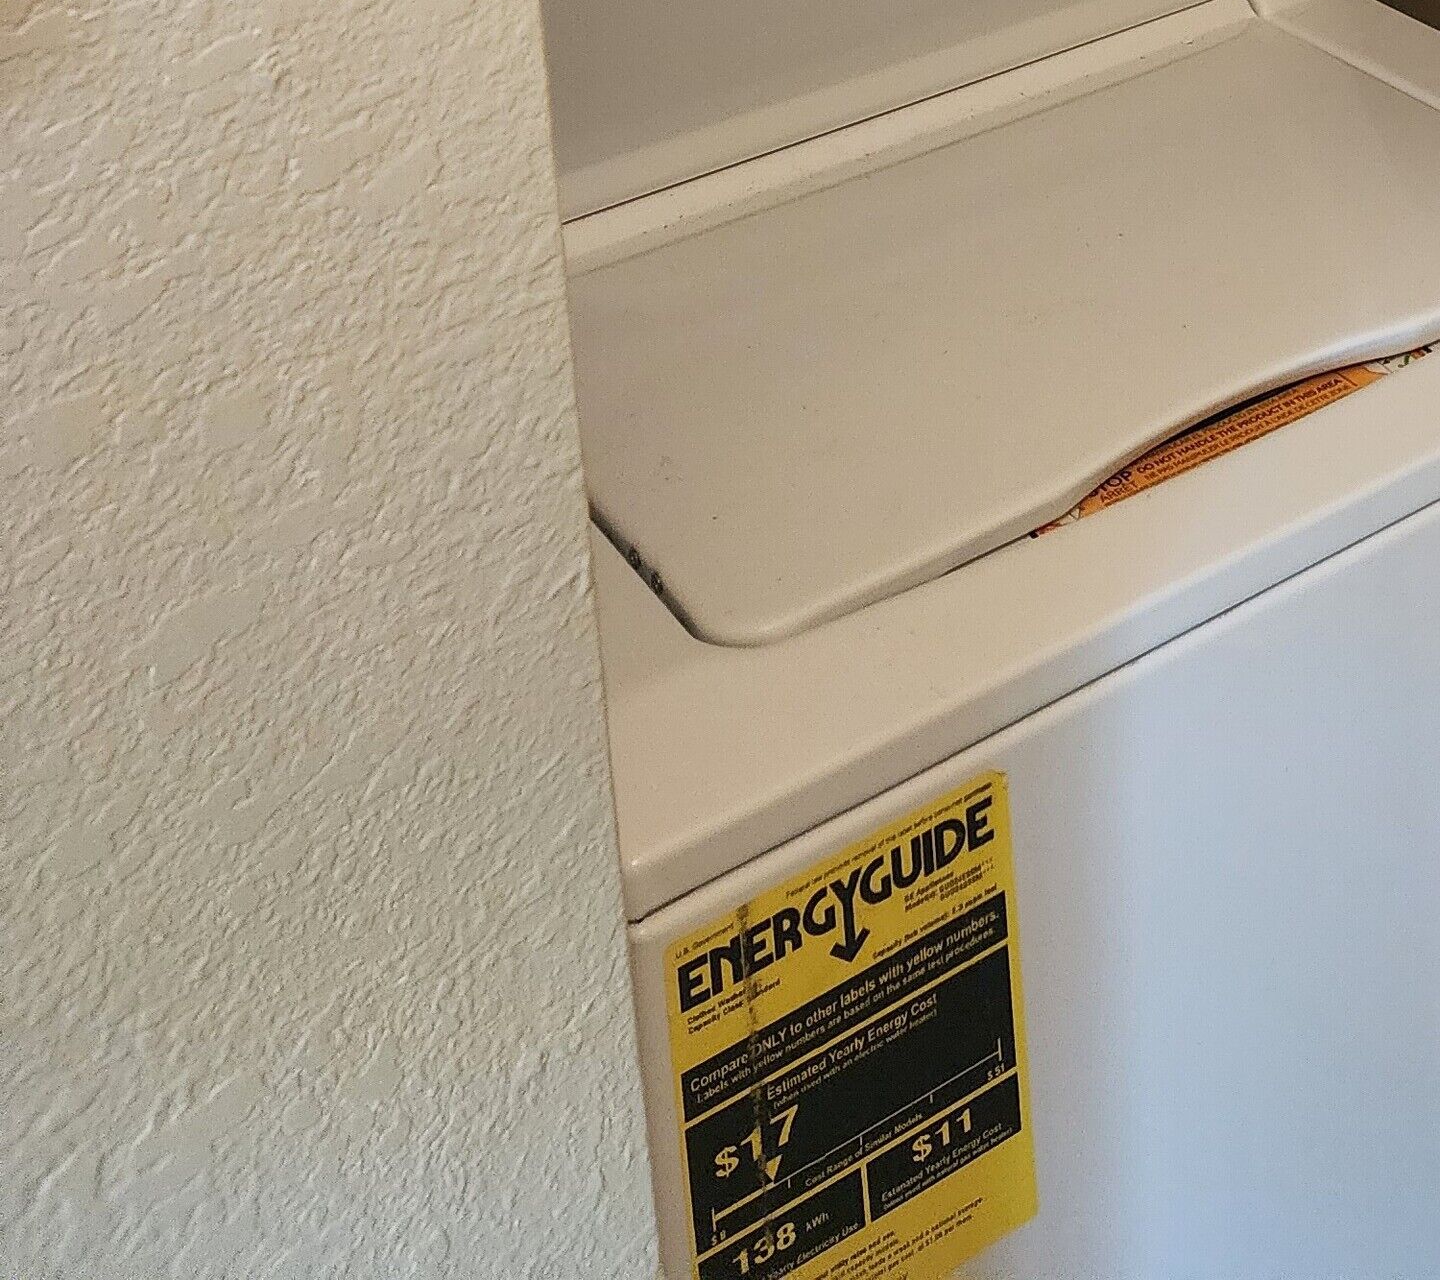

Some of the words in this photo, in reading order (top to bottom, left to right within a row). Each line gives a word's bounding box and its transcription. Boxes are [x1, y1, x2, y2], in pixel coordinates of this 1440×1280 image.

[1219, 424, 1238, 438] THE
[1237, 403, 1284, 429] PRODUCT
[1317, 376, 1343, 393] AREA
[678, 795, 995, 1013] ENERGYGUIDE
[690, 1052, 749, 1092] Compare
[790, 1019, 803, 1037] to
[806, 1001, 838, 1028] other
[840, 980, 877, 1008] labels
[878, 963, 904, 985] with
[906, 941, 944, 972] yellow
[946, 911, 1000, 947] numbers.
[696, 1080, 729, 1104] Labels
[731, 1065, 750, 1084] with
[752, 1051, 784, 1073] yellow
[828, 1015, 842, 1030] are
[843, 999, 871, 1020] based
[887, 980, 901, 995] the
[767, 1057, 827, 1100] Estimated
[828, 1036, 865, 1064] Yearly
[867, 1011, 908, 1043] Energy
[910, 993, 938, 1016] Cost
[714, 1103, 800, 1179] $17
[912, 1107, 972, 1163] $11
[982, 1123, 1002, 1139] Cost
[805, 1170, 826, 1188] Cost
[731, 1222, 797, 1275] 138
[841, 1222, 859, 1239] Use
